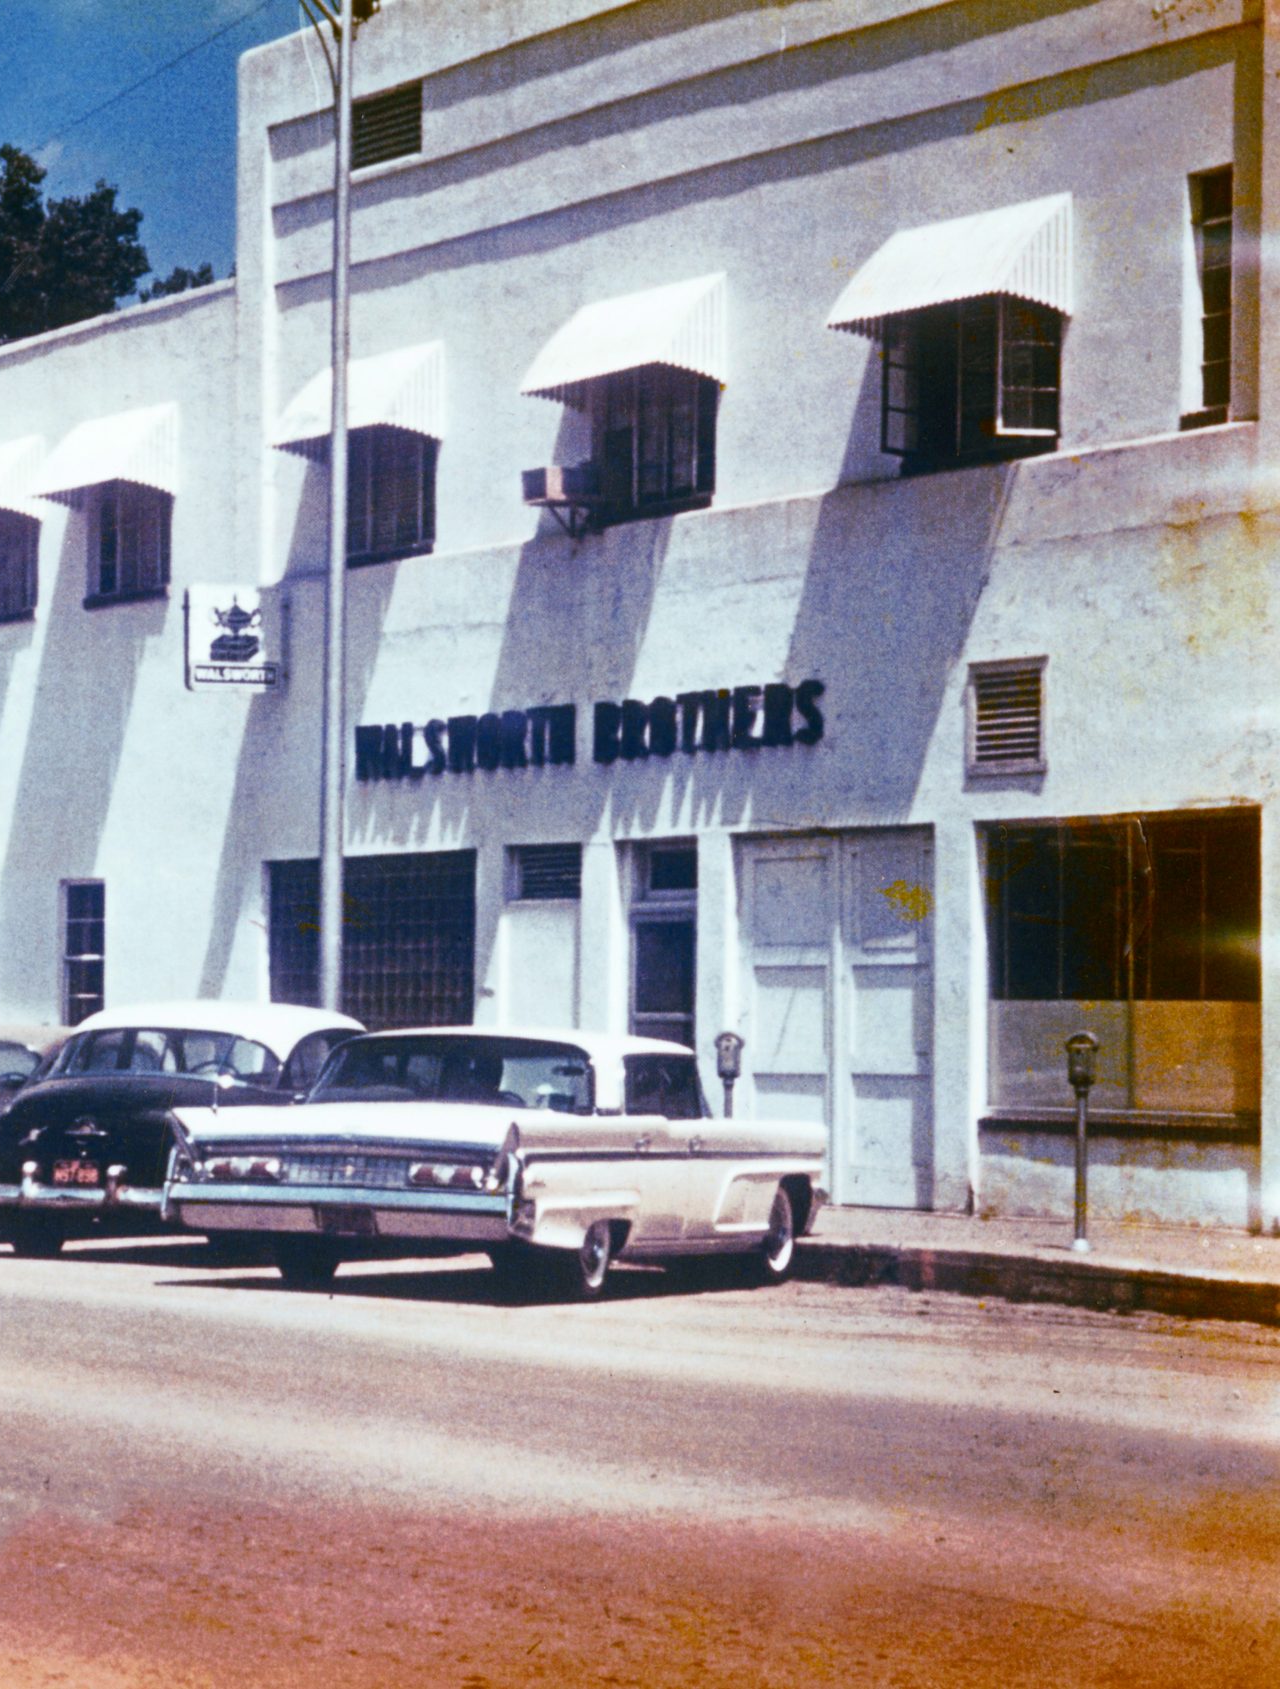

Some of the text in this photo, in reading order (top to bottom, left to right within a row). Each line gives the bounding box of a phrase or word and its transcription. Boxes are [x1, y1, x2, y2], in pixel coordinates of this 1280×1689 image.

[195, 668, 274, 681] WALSWORTH
[355, 679, 824, 781] WALSWORTH BROTHERS
